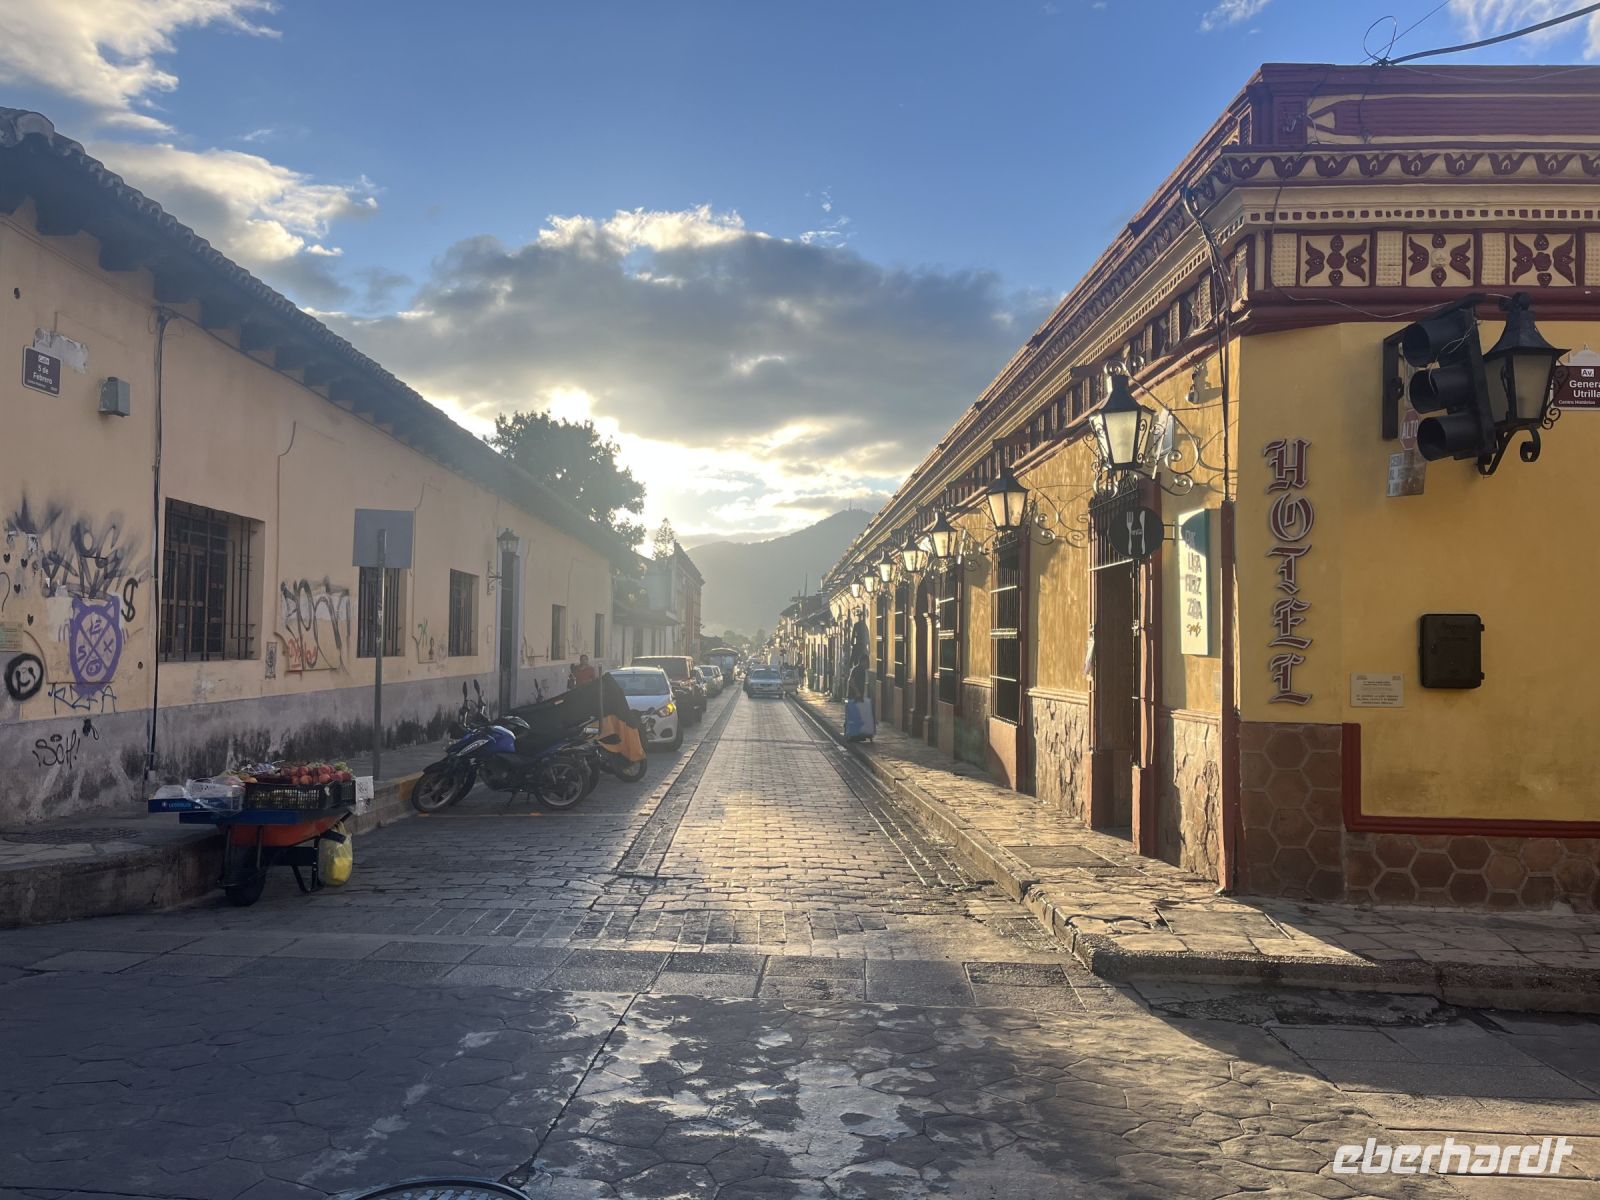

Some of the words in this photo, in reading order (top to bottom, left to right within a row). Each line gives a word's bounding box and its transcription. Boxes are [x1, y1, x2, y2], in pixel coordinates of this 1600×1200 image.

[33, 371, 53, 385] Febrero
[1573, 389, 1600, 398] Utrilla
[1401, 420, 1419, 440] ALTO
[1263, 438, 1314, 706] HOTEL
